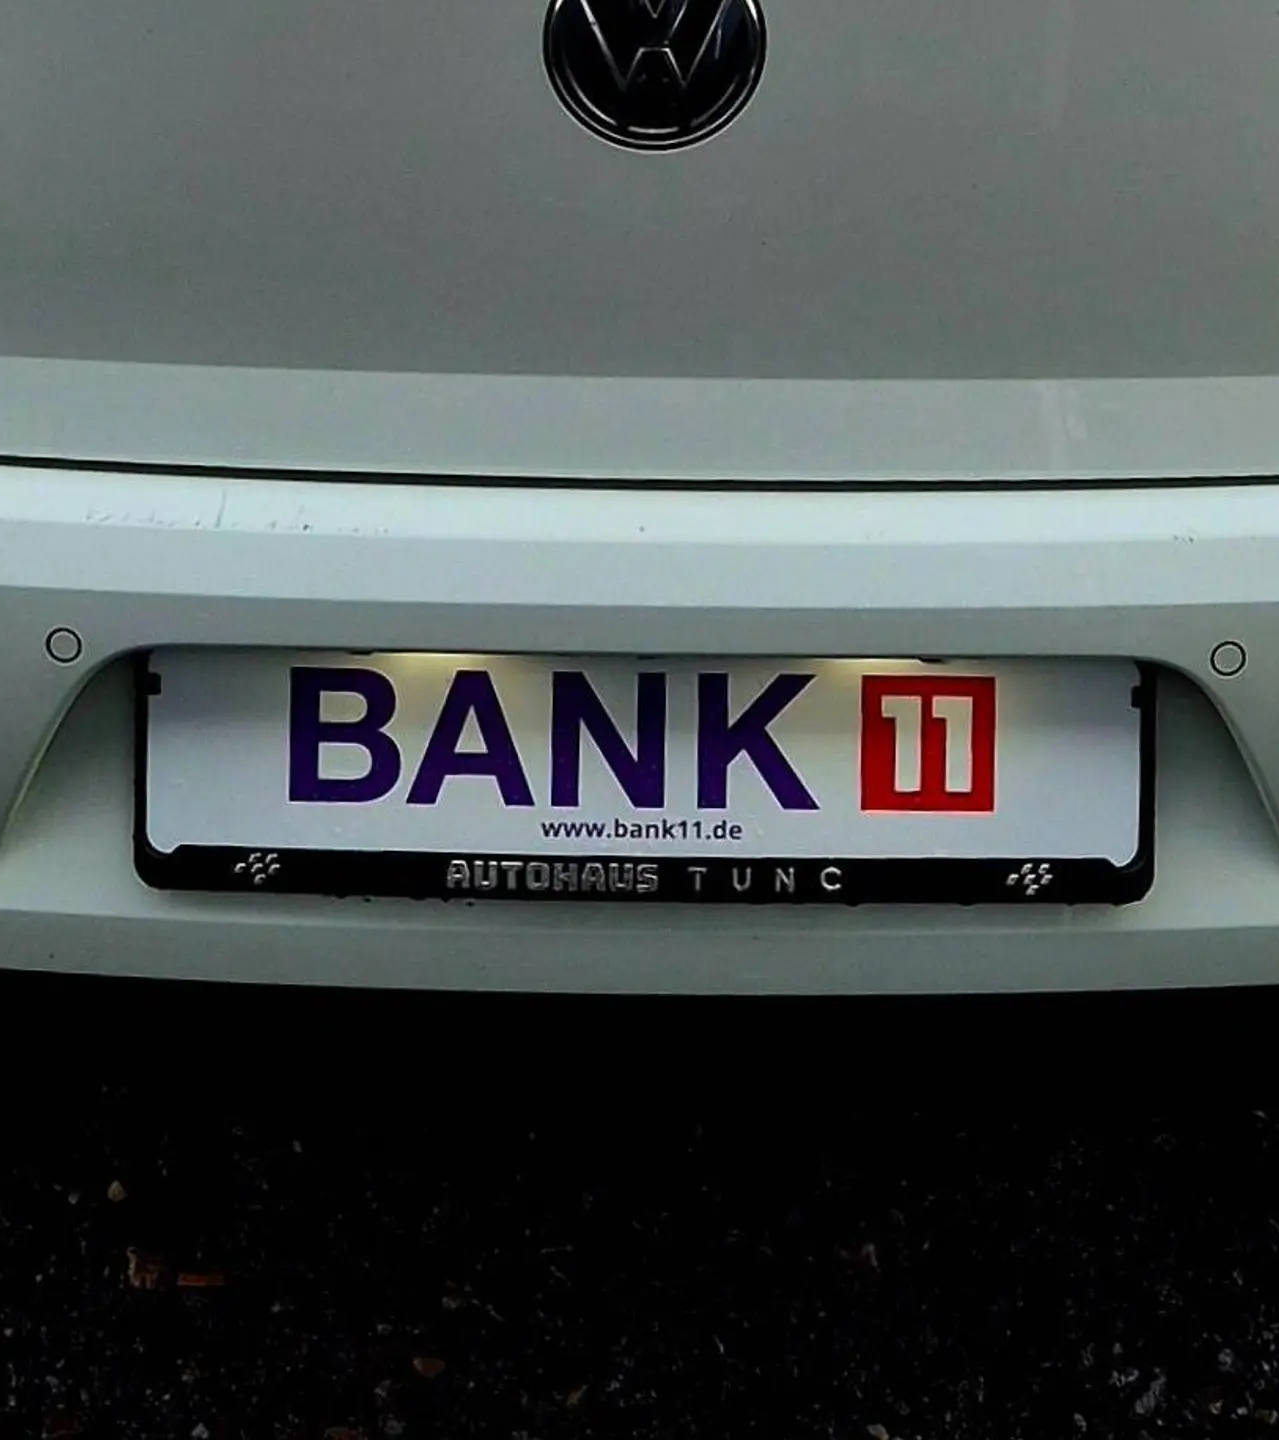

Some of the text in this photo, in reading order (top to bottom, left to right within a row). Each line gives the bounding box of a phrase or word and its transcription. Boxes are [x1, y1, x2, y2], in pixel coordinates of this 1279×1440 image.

[288, 665, 974, 811] BANK 11
[540, 818, 743, 842] www.bank11.de
[447, 859, 659, 893] AUTOHAUS
